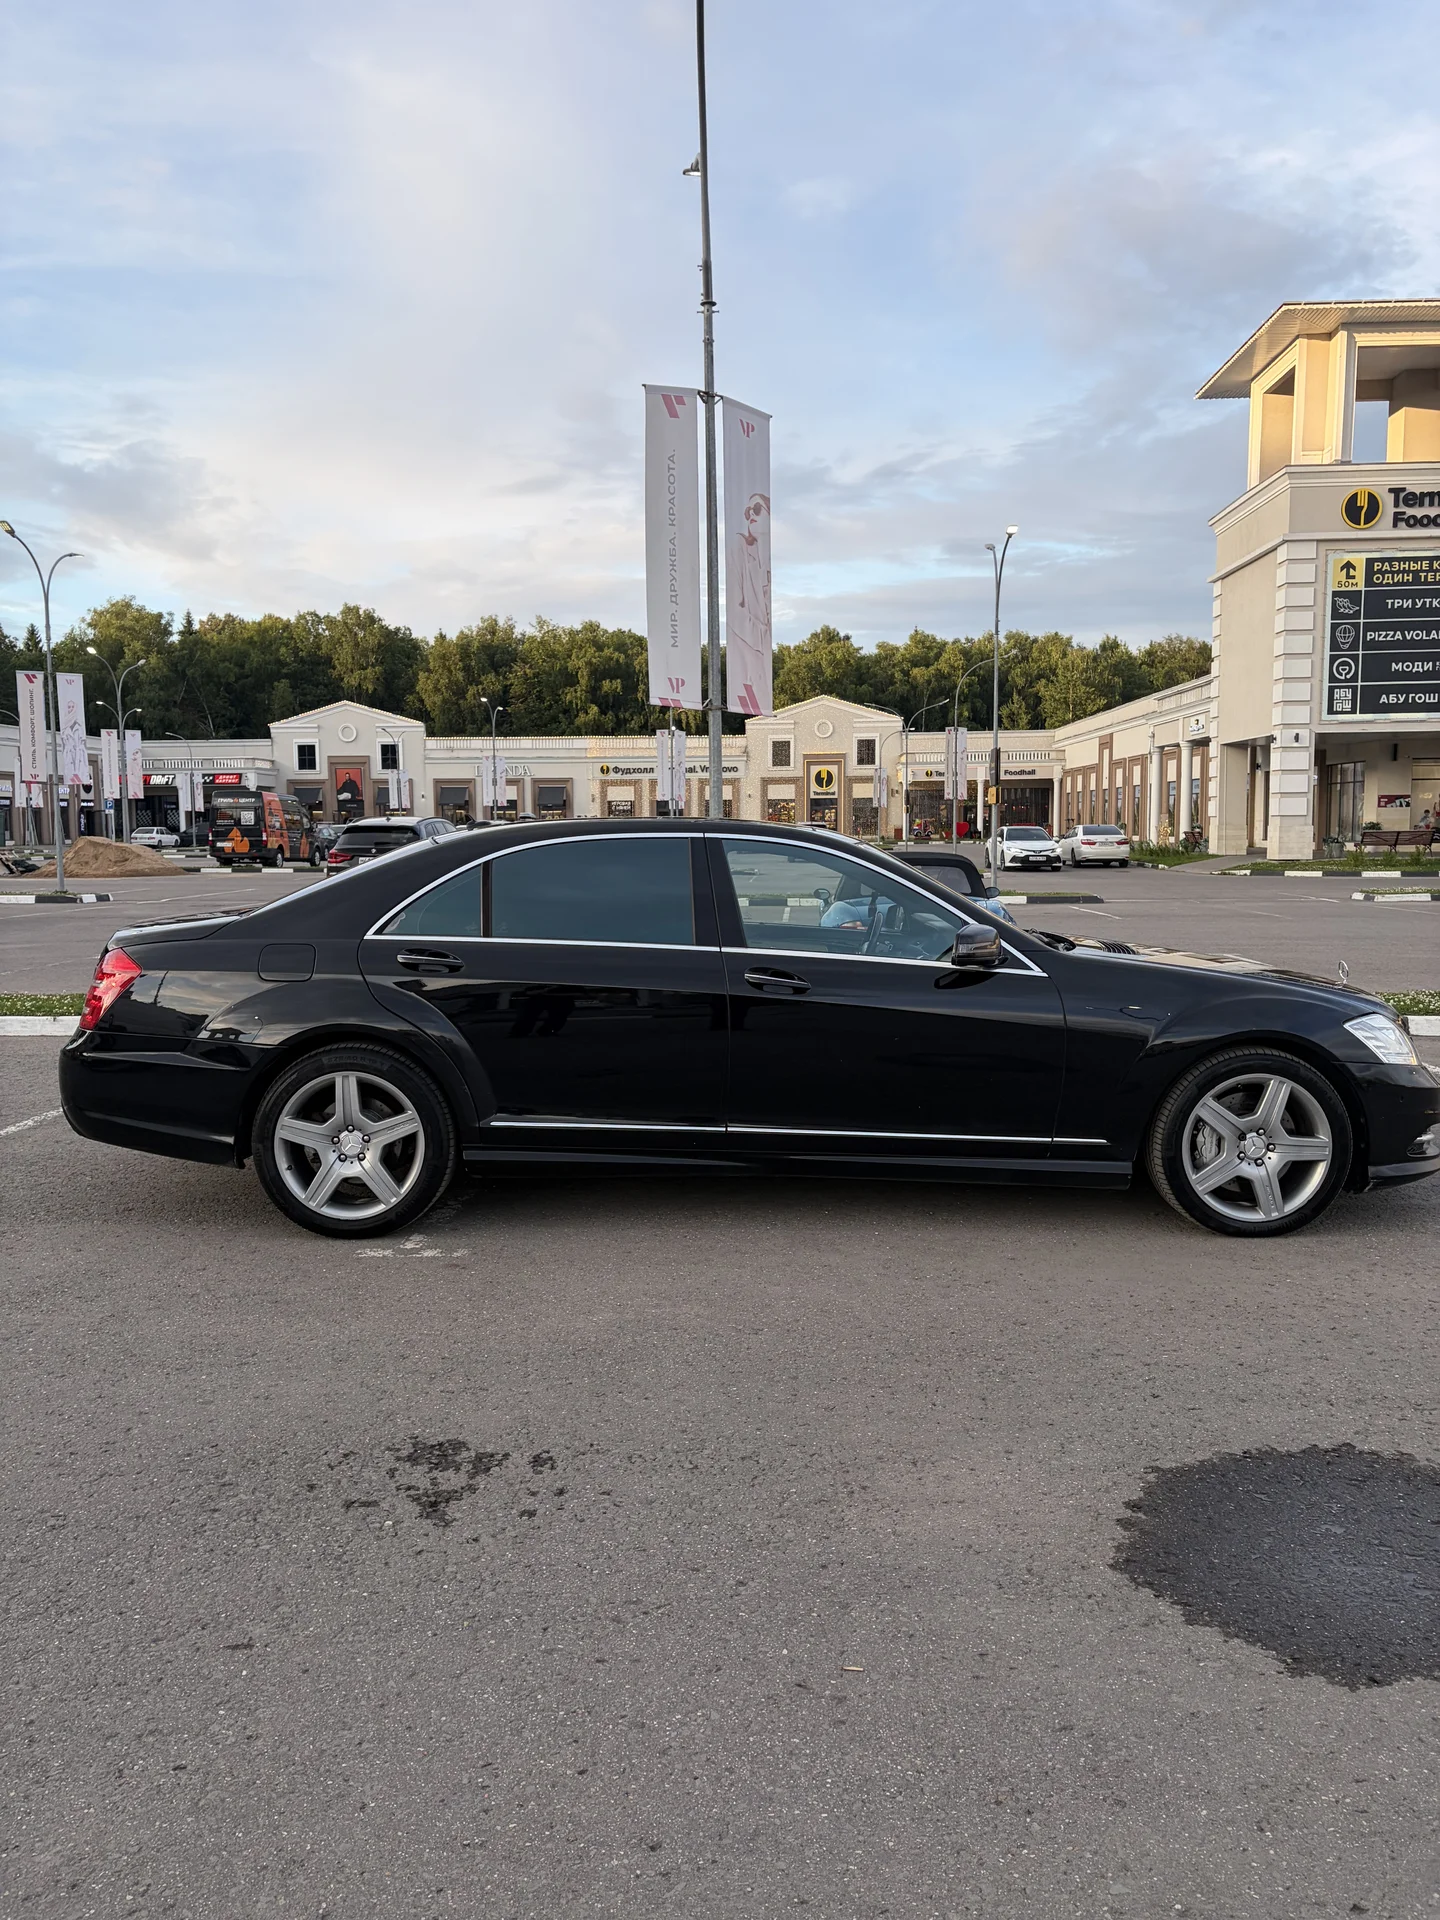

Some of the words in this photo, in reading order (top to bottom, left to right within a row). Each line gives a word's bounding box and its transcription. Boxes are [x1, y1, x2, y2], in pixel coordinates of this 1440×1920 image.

[667, 449, 676, 527] КРАСОТА.
[668, 532, 679, 605] ДРУЖБА.
[1373, 561, 1430, 572] РАЗНЫЕ
[1373, 573, 1412, 585] ОДИН
[1385, 599, 1412, 609] ТРИ
[670, 610, 678, 648] МИР.
[1366, 631, 1403, 641] PIZZA
[1391, 661, 1433, 673] МОДИ
[1379, 694, 1406, 704] АБУ
[1408, 693, 1439, 703] ГОШ
[612, 764, 655, 775] Фудхолл
